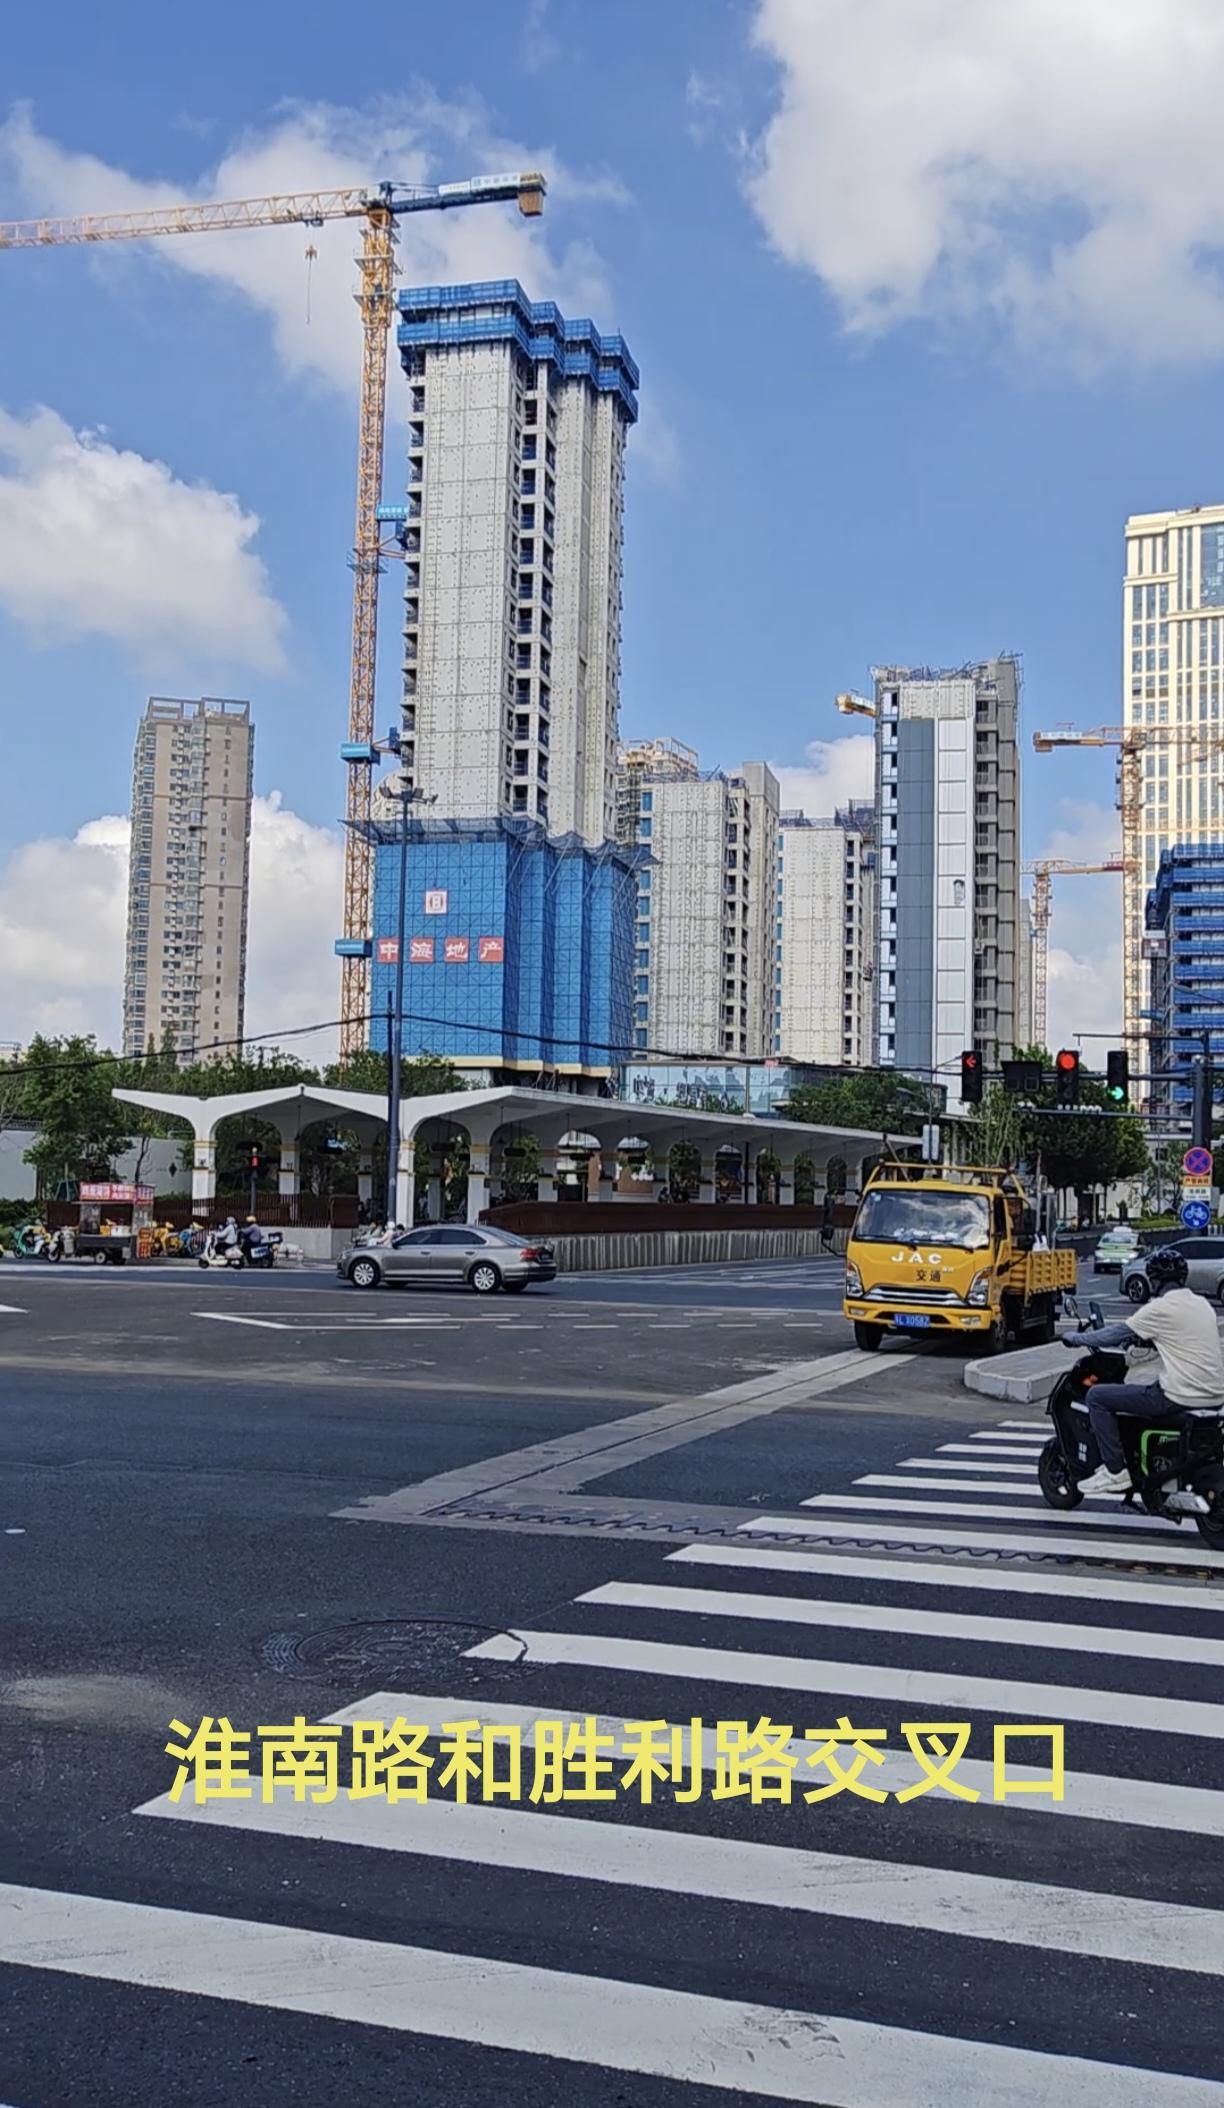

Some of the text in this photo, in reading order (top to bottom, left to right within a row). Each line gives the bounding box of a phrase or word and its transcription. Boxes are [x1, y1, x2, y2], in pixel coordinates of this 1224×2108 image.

[379, 941, 502, 960] 中海地产
[891, 1251, 942, 1265] JAC
[915, 1269, 941, 1282] 交通
